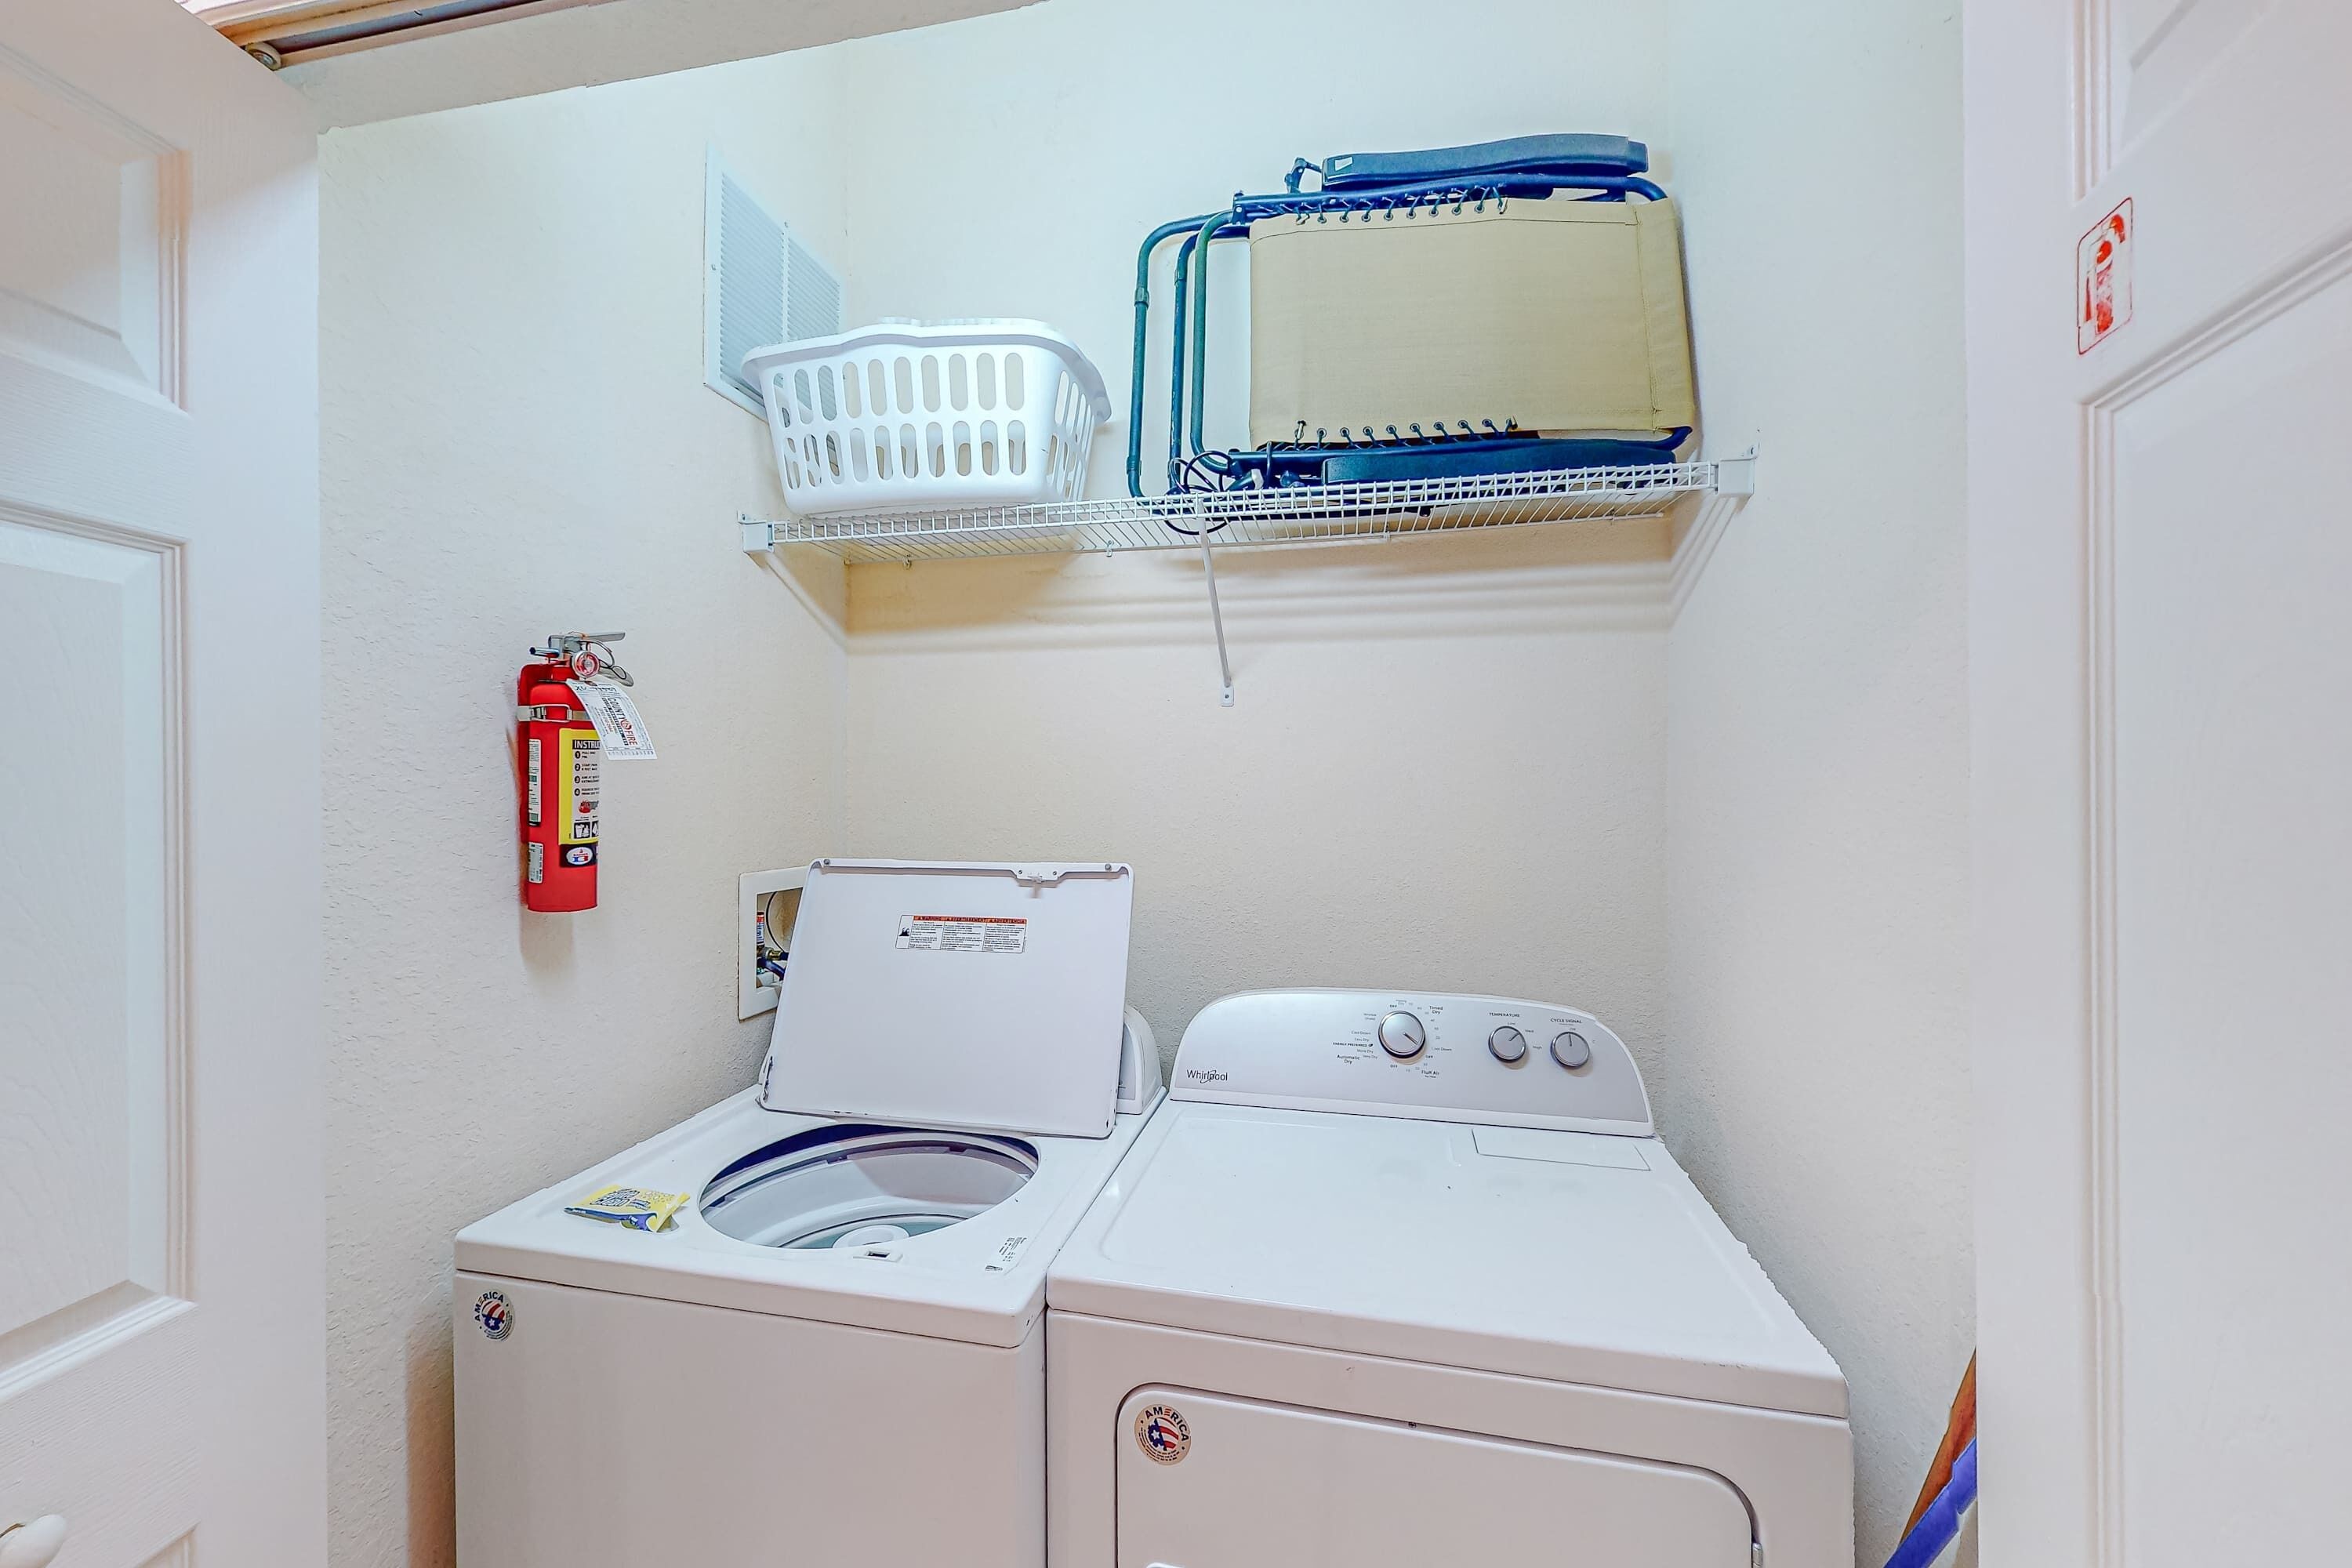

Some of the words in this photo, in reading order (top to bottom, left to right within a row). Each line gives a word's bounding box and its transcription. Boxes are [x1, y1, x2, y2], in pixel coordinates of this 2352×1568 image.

[608, 697, 627, 721] COUNTY
[624, 731, 638, 746] FIRE
[1186, 1069, 1228, 1083] Whirlpool
[474, 1291, 504, 1322] AMERICA
[1145, 1406, 1189, 1441] AMERICA
